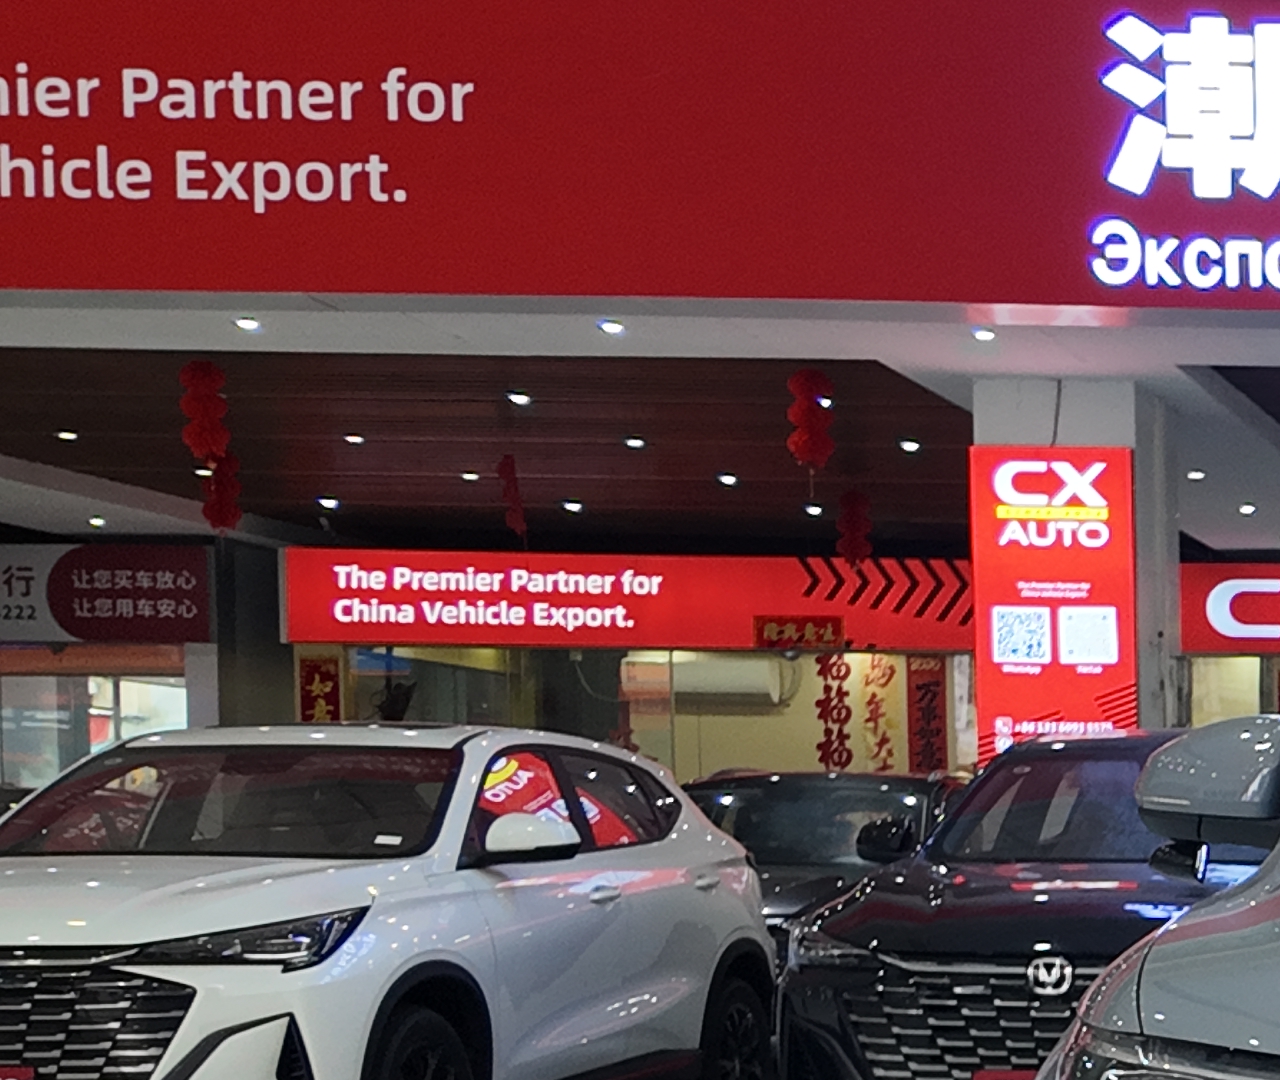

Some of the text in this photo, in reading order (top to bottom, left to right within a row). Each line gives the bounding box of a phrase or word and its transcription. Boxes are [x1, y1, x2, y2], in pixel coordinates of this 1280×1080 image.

[0, 62, 475, 122] ier Partner for
[0, 142, 408, 213] hicle Export.
[993, 460, 1109, 506] CX
[998, 519, 1110, 548] AUTO
[1, 564, 36, 598] 行
[71, 568, 198, 590] 让您买车放心
[332, 564, 664, 596] The Premier Partner for
[0, 604, 37, 620] 222
[72, 597, 199, 619] 让您用车安心
[332, 598, 635, 632] China Vehicle Export.
